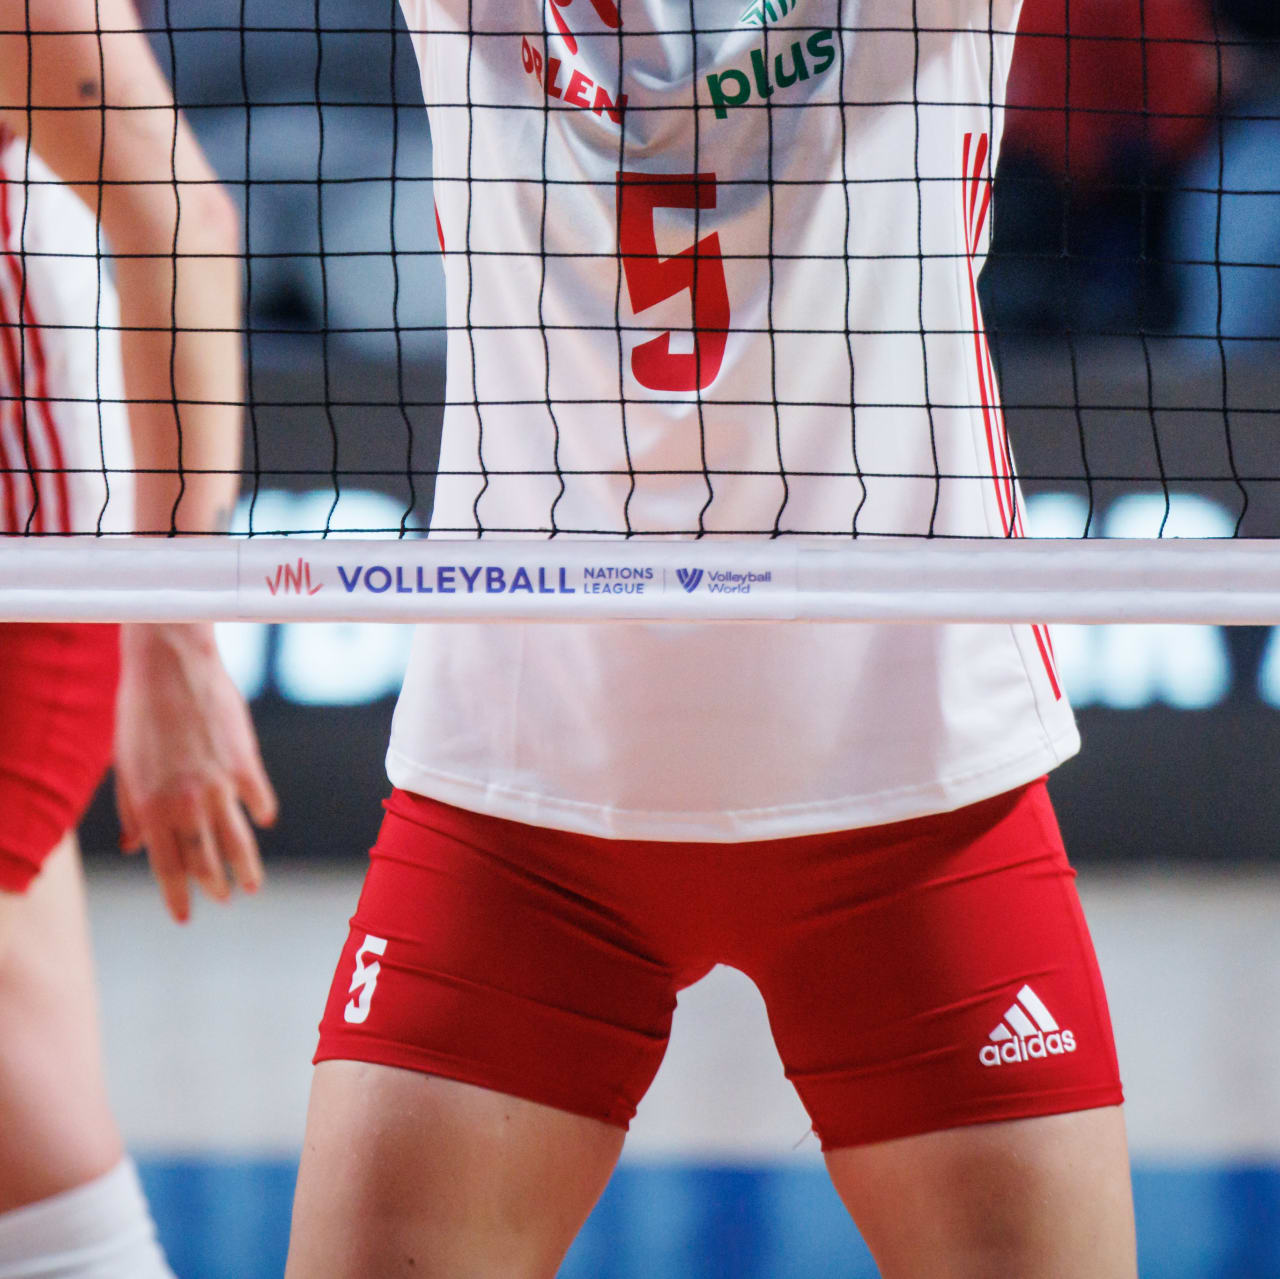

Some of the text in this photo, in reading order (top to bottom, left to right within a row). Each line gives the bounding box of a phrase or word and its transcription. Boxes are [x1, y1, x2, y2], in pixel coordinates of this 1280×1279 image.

[521, 35, 629, 125] ORLEN
[706, 29, 835, 120] plus
[616, 171, 730, 391] 5
[265, 557, 576, 596] VNL VOLLEYBALL
[584, 567, 654, 580] NATIONS
[584, 582, 645, 594] LEAGUE
[708, 571, 772, 583] Volleyball
[708, 583, 751, 594] World
[344, 933, 388, 1024] 5
[978, 1029, 1077, 1067] adidas
